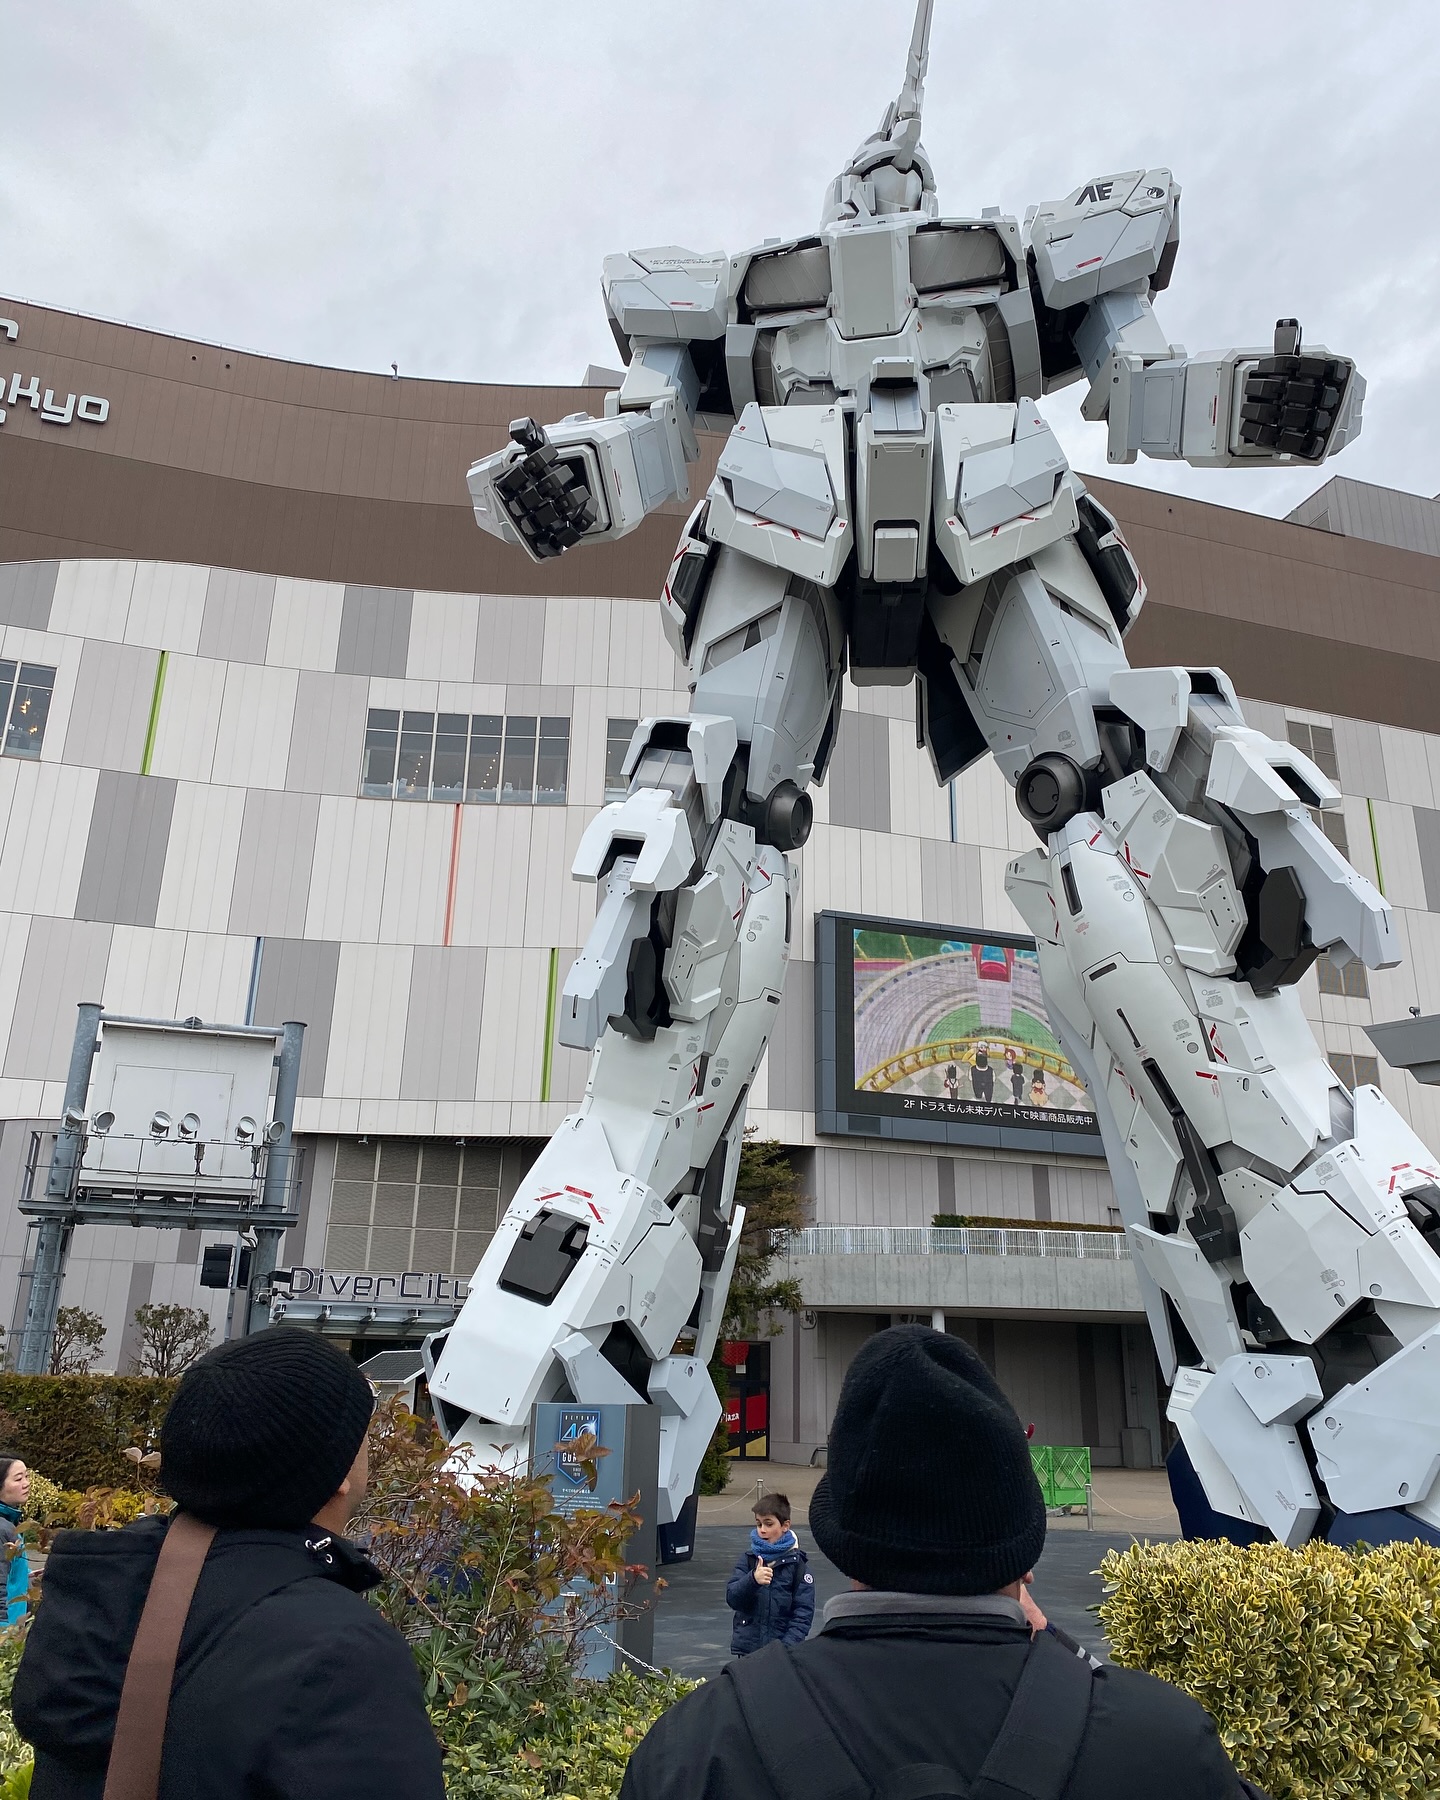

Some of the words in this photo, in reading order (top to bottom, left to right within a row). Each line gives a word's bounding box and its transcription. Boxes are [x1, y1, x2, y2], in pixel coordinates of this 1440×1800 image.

[0, 373, 110, 424] kyo
[903, 1099, 916, 1109] 2F
[919, 1101, 1093, 1125] ドラえもん未来デパートで映画商品販売中
